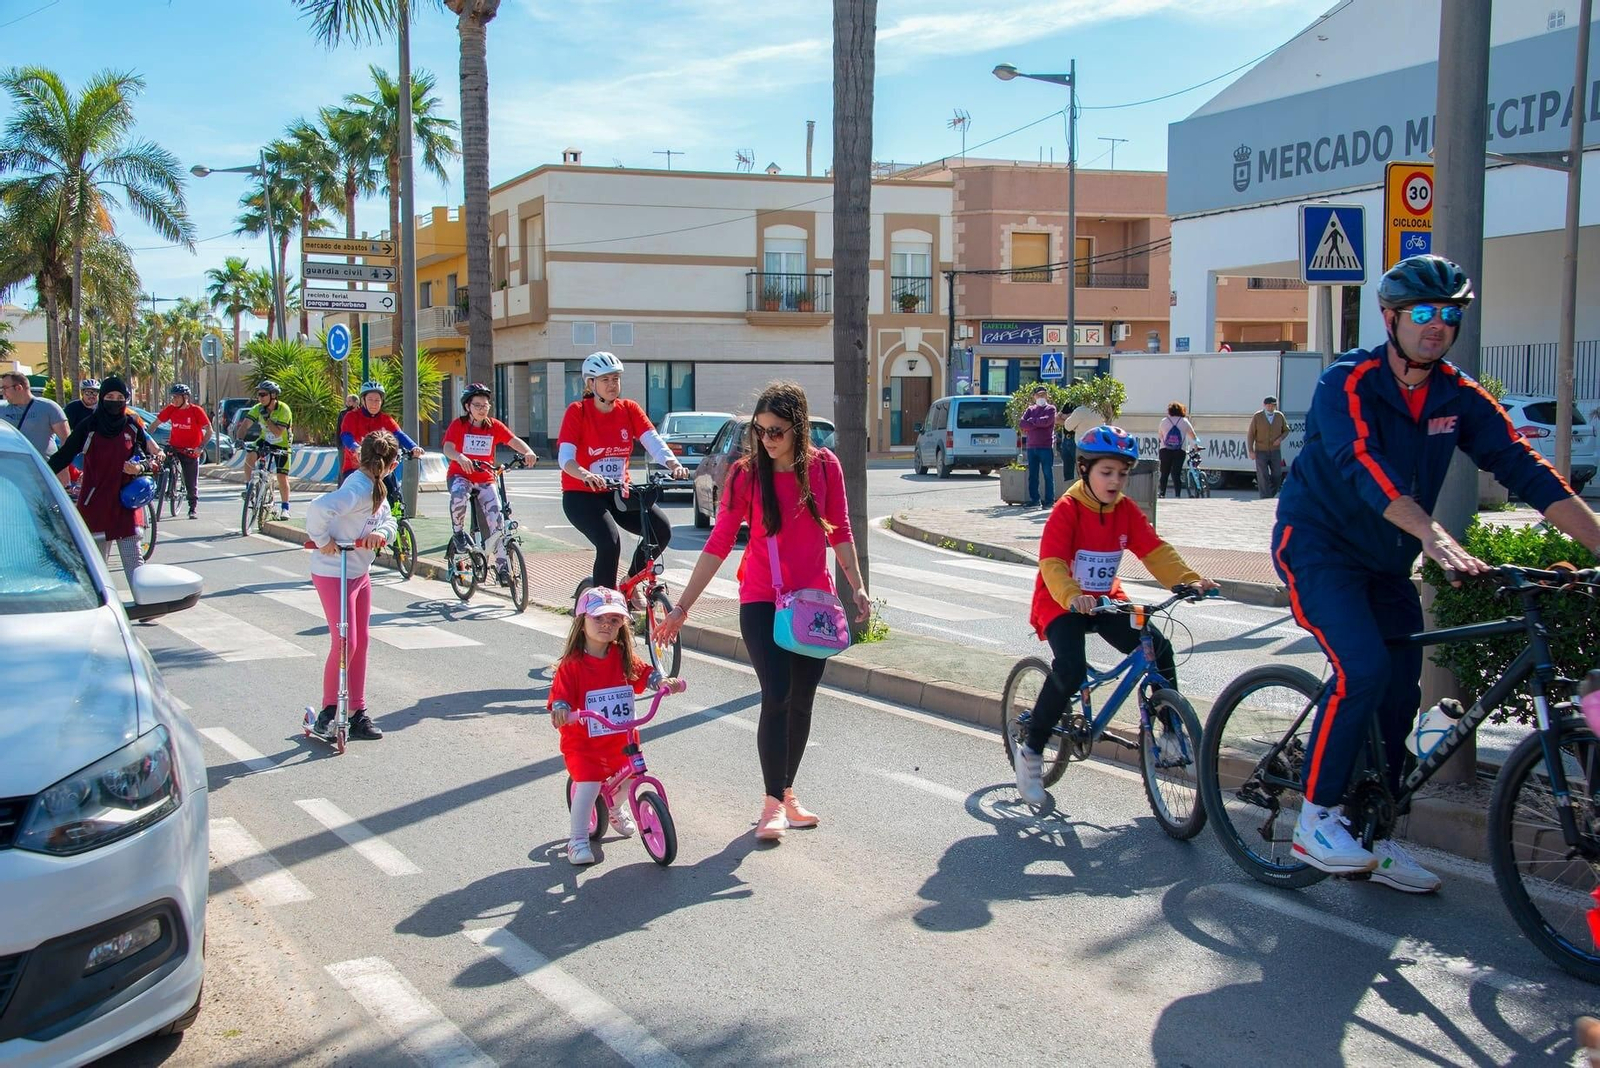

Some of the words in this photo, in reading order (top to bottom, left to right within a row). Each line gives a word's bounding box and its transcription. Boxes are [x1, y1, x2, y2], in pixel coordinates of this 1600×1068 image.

[1258, 125, 1394, 183] MERCADO
[1409, 186, 1429, 200] 30
[343, 243, 368, 251] abastos
[306, 267, 340, 275] guardia
[599, 464, 618, 472] 108
[1088, 566, 1116, 578] 163
[601, 703, 630, 719] 145
